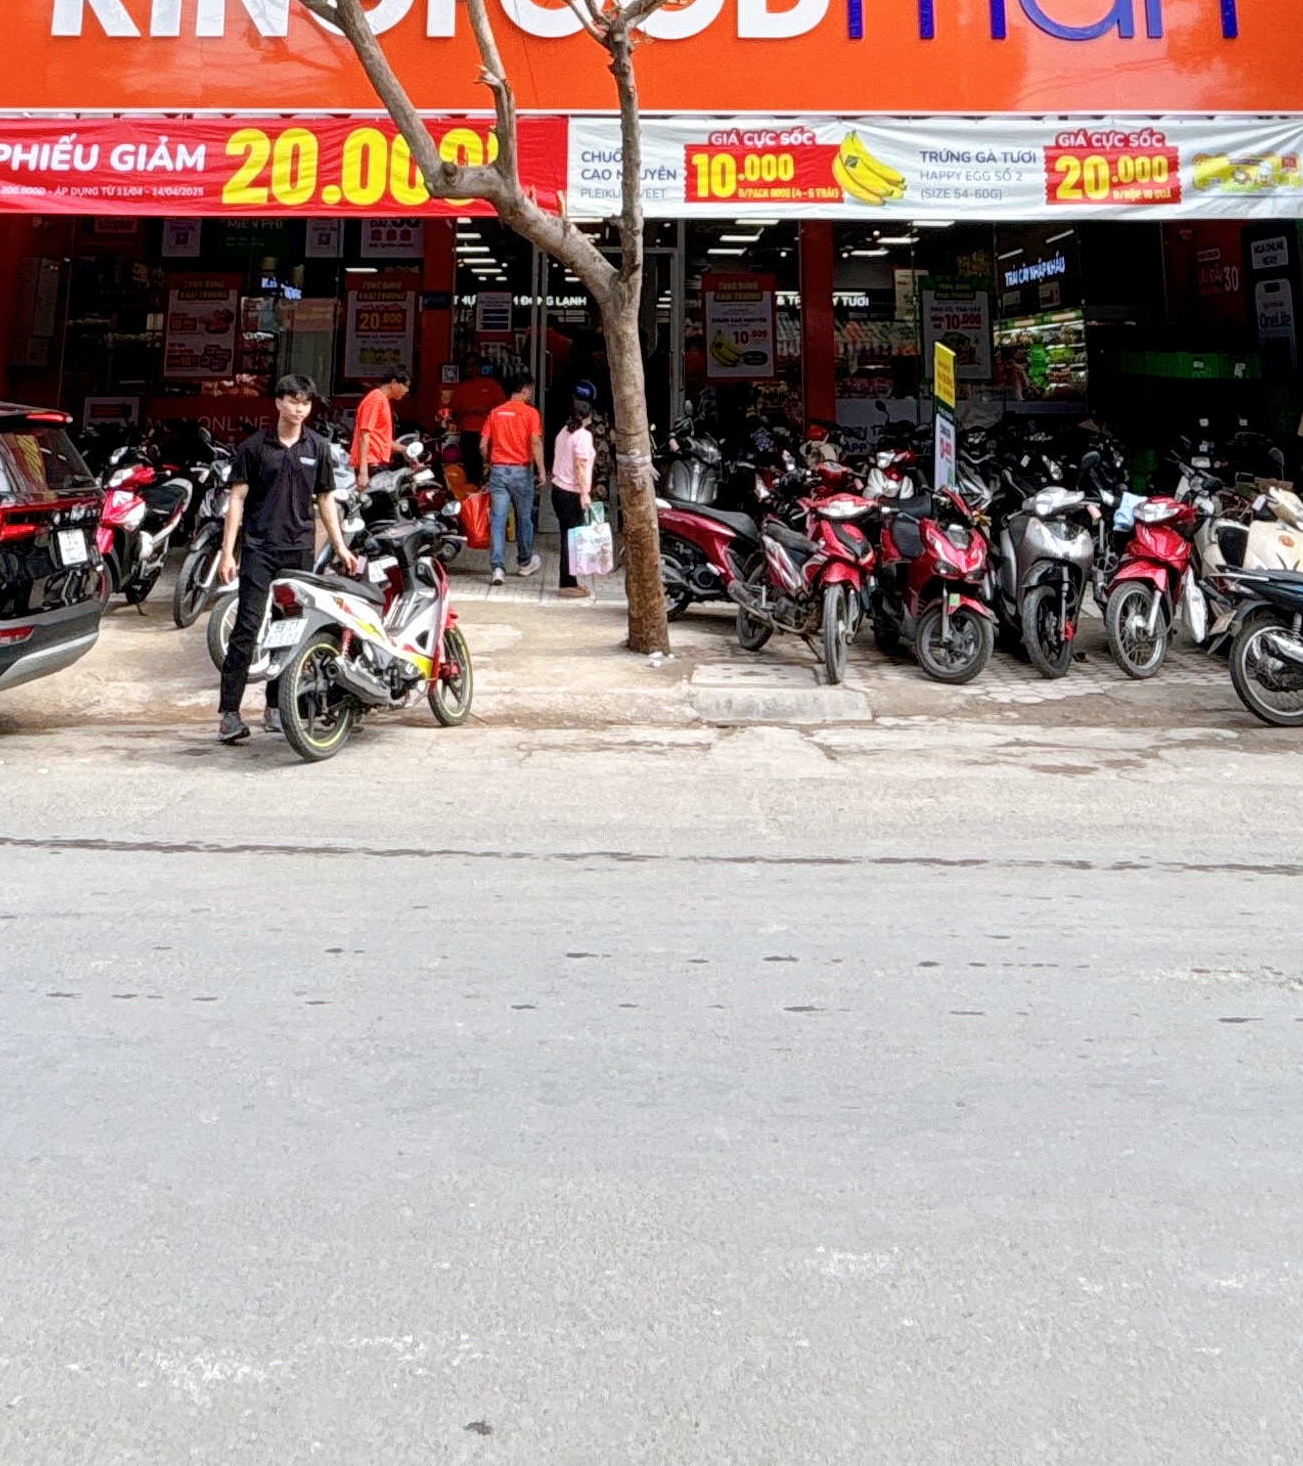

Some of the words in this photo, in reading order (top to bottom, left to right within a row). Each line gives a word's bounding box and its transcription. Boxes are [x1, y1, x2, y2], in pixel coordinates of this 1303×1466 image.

[711, 130, 738, 146] GIÁ
[744, 131, 776, 148] CỰC
[780, 127, 814, 146] SỐC
[1058, 131, 1089, 147] GIÁ
[1094, 131, 1125, 150] CỰC
[1129, 128, 1164, 147] SỐC
[110, 135, 206, 172] GIẢM
[919, 148, 972, 165] TRỨNG
[975, 148, 997, 165] GÀ
[1001, 150, 1037, 164] TƯƠI
[581, 168, 613, 181] CAO
[616, 165, 677, 181] NUYÊN
[691, 153, 795, 198] 10.000
[919, 170, 962, 182] HAPPY
[965, 170, 992, 182] EGG
[995, 165, 1012, 182] SỐ
[1015, 170, 1023, 182] 2
[1055, 154, 1169, 200] 20.000
[580, 187, 621, 199] PLEIKU
[920, 187, 951, 201] (SIZE
[953, 187, 1003, 201] 54-60G)
